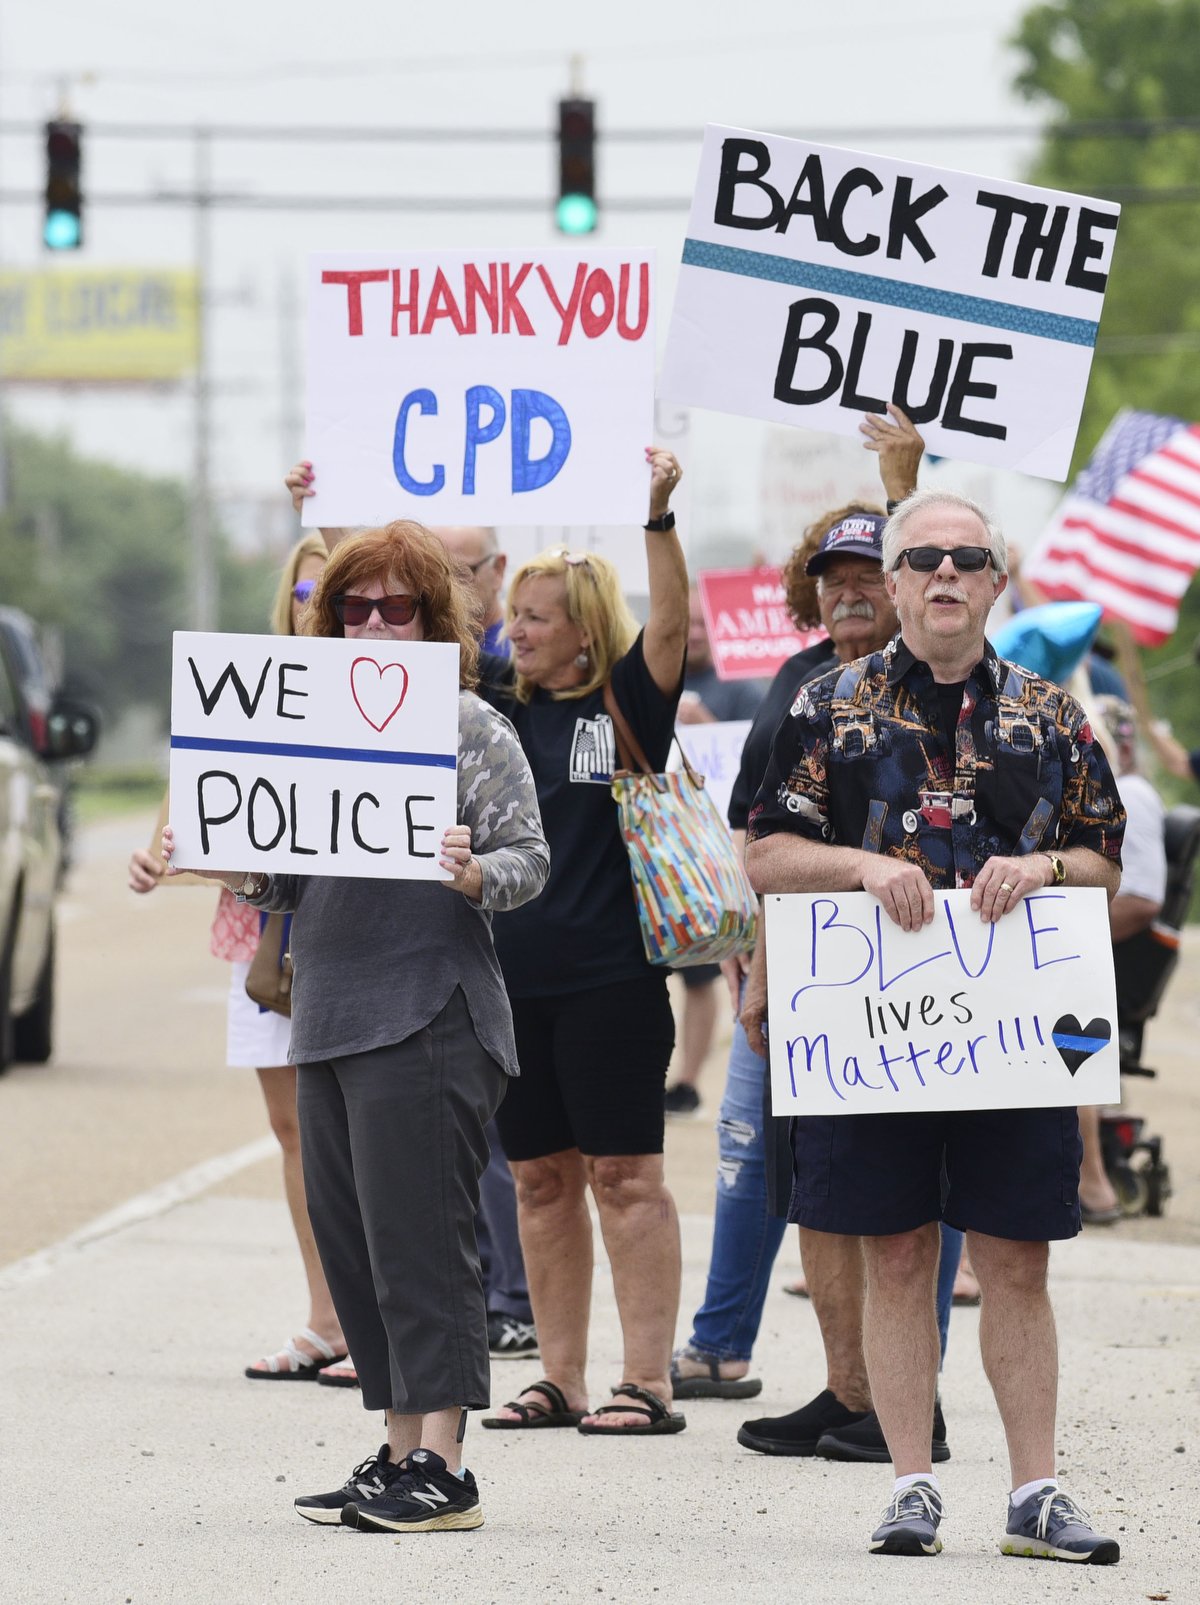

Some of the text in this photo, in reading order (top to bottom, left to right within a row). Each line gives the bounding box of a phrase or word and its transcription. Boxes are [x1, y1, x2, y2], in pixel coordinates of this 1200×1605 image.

[714, 137, 1118, 294] BACK THE
[321, 261, 649, 346] THANK YOU
[774, 298, 1014, 441] BLUE
[392, 385, 572, 497] CPD
[187, 657, 310, 720] WE
[197, 769, 436, 859] POLICE
[791, 892, 1082, 1012] BLUE
[787, 1013, 1047, 1102] Matter!!!
[865, 990, 974, 1039] lives
